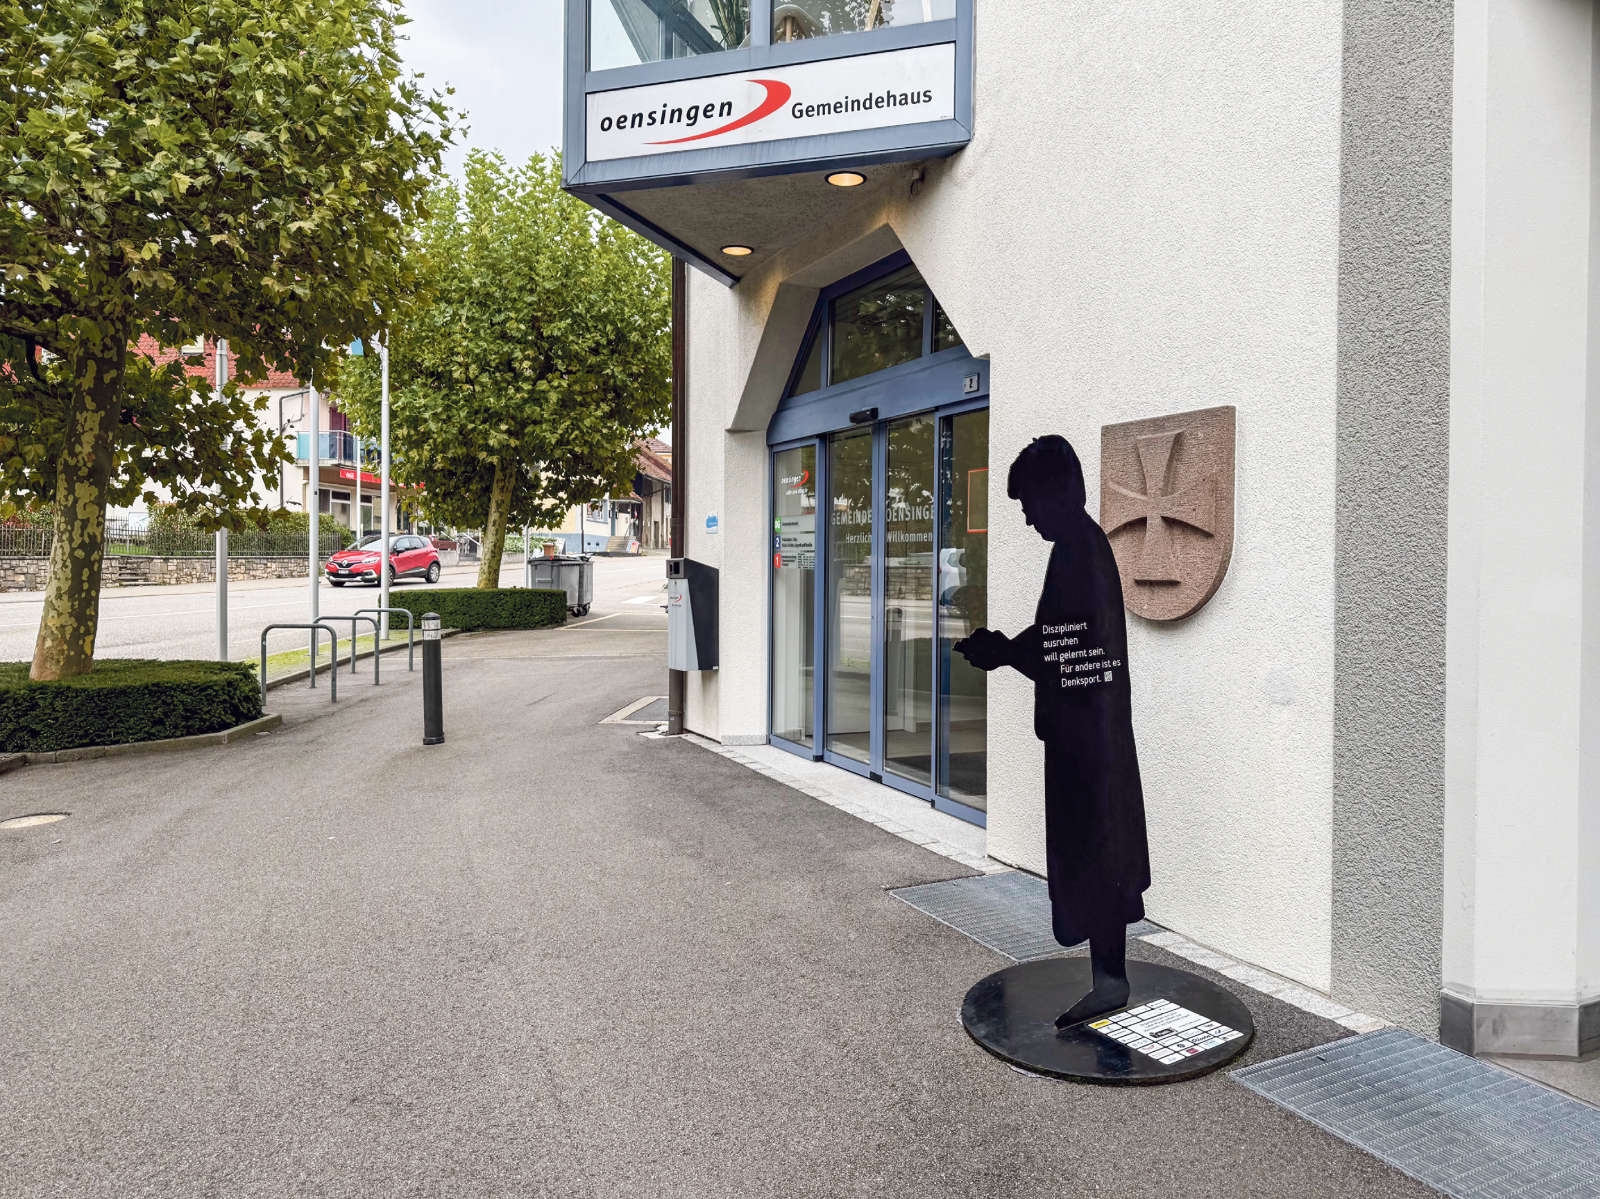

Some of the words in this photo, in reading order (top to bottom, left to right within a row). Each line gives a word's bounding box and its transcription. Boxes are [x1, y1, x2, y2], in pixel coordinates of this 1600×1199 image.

[600, 99, 734, 132] oensingen
[791, 87, 934, 119] Gemeindehaus
[832, 508, 873, 525] GEMEINDE
[887, 530, 933, 543] Willkommen
[1042, 622, 1088, 635] Diszipliniert
[1043, 637, 1079, 648] ausruhen
[1044, 652, 1058, 662] will
[1060, 649, 1087, 662] gelernt
[1089, 648, 1105, 657] sein.
[1061, 663, 1073, 674] Für
[1075, 661, 1100, 672] andere
[1102, 660, 1111, 669] ist
[1112, 659, 1121, 667] es
